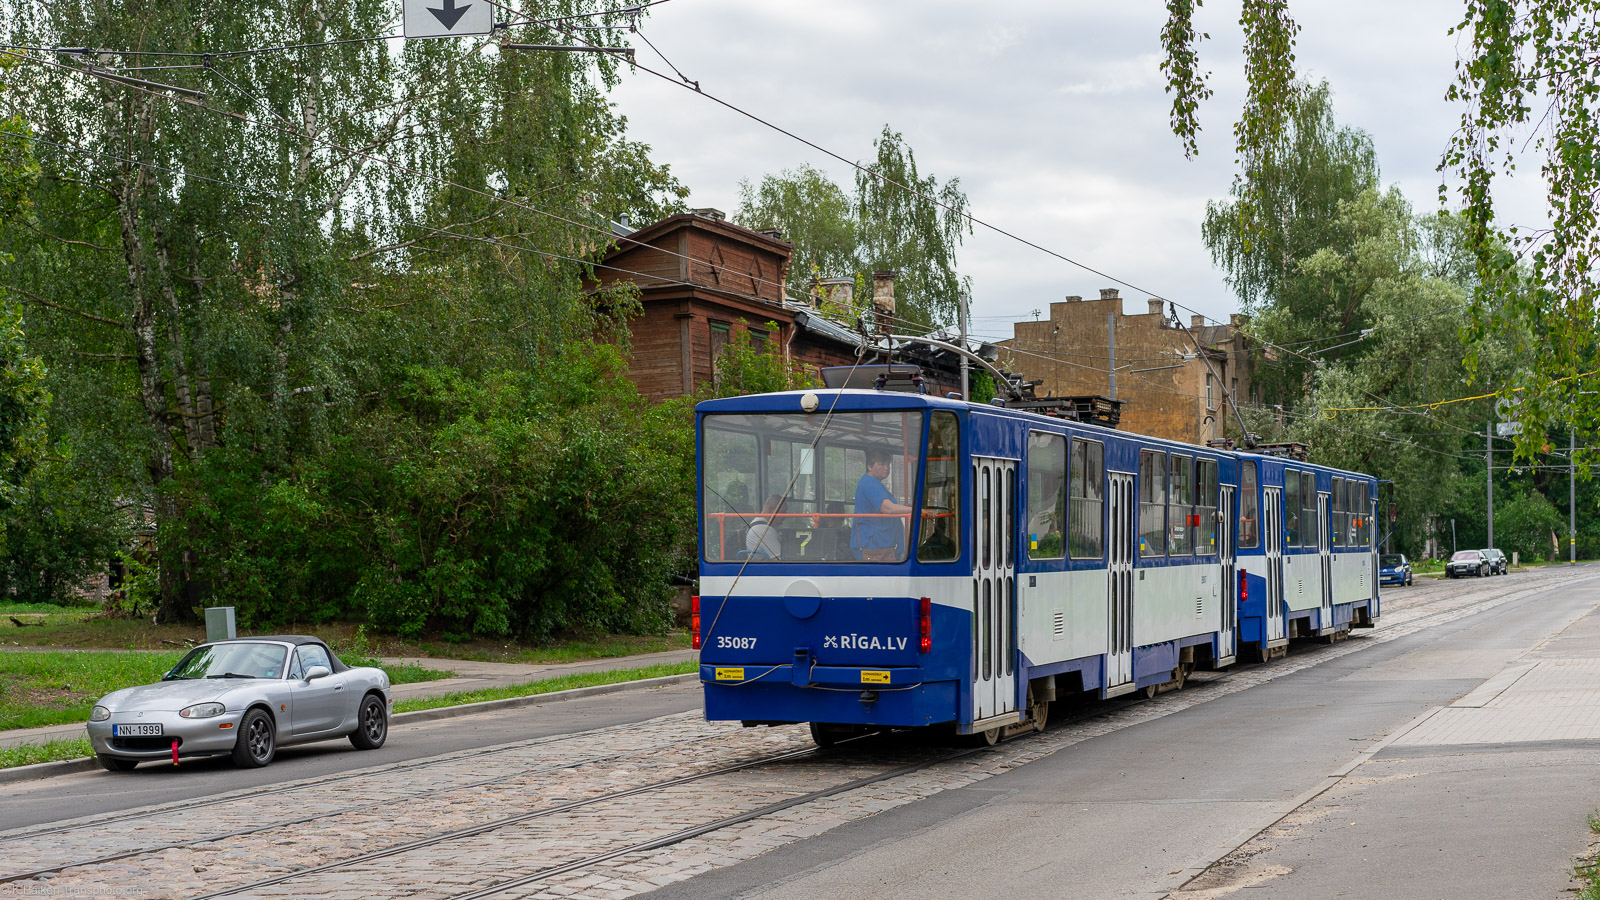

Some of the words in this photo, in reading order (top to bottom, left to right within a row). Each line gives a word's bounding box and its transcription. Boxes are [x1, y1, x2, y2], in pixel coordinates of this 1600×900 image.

[795, 530, 813, 556] 7
[717, 636, 757, 649] 35087
[840, 633, 908, 650] RĪGA.LV
[119, 725, 160, 735] NN-1999
